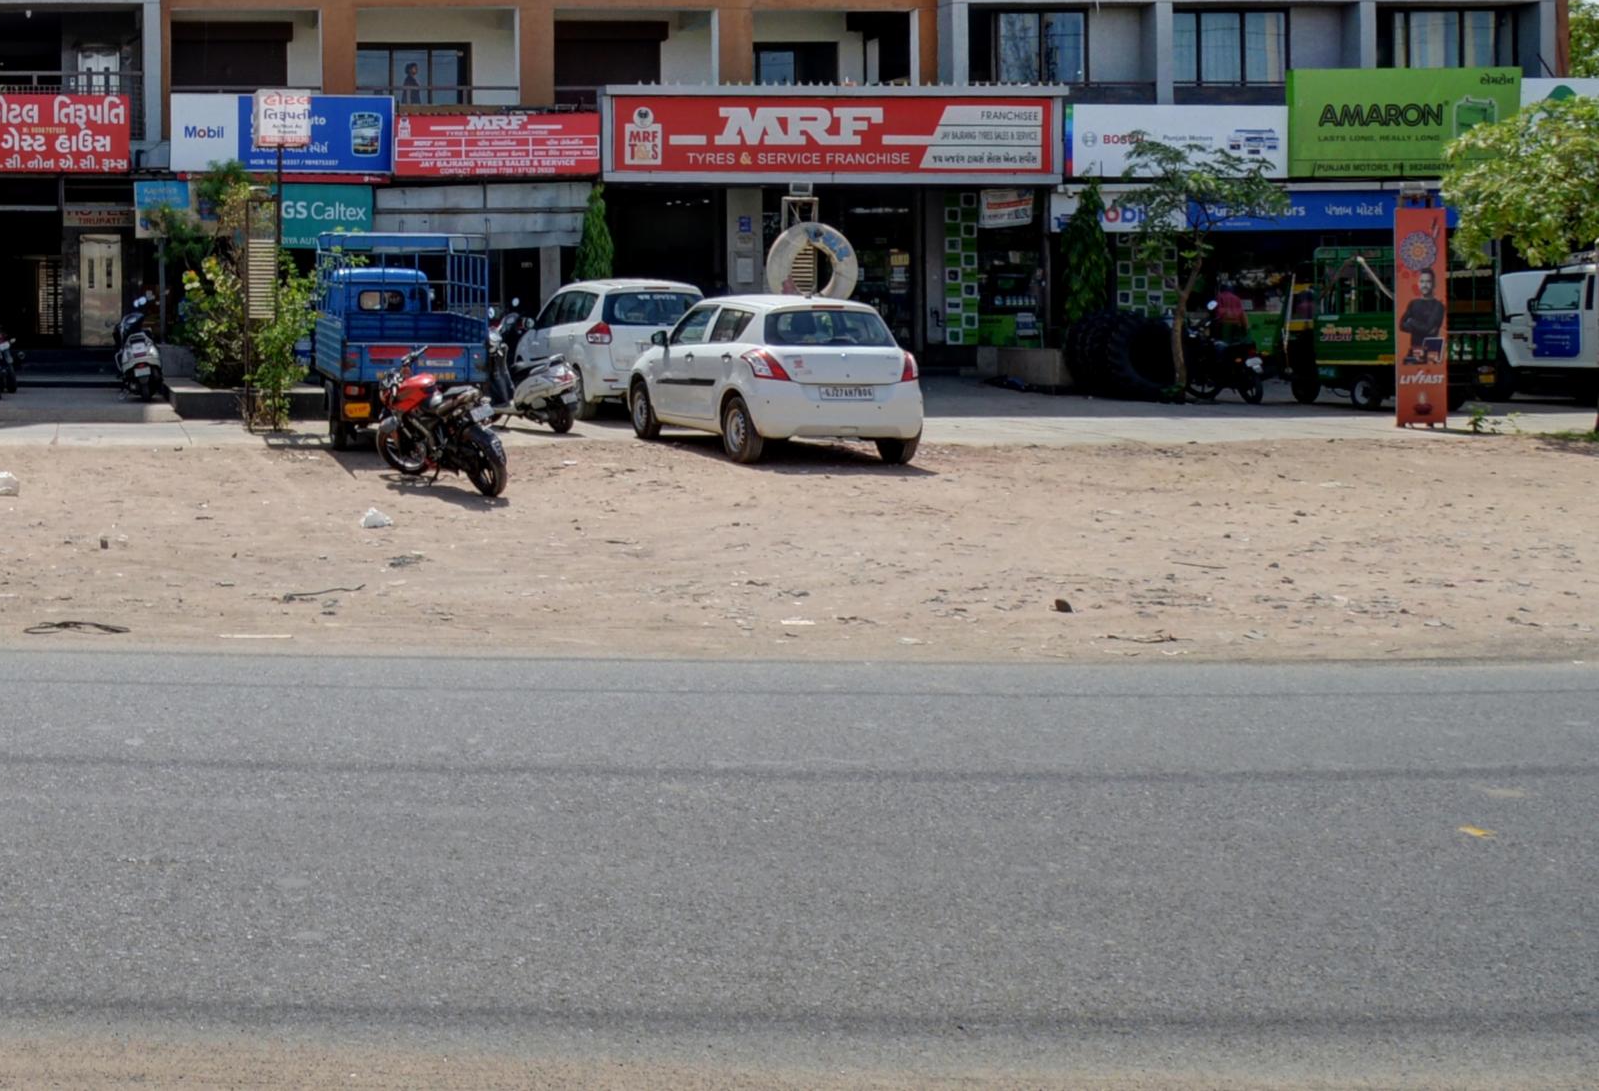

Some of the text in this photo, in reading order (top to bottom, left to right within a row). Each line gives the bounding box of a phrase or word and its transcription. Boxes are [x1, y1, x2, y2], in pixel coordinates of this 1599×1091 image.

[53, 95, 125, 128] તિરૂપતિ
[980, 111, 1039, 121] FRANCHISEE
[1318, 103, 1443, 127] AMARON
[465, 115, 528, 130] MRF
[714, 106, 884, 146] MRF
[184, 126, 225, 139] Mobil
[628, 130, 658, 143] MRF
[1318, 134, 1346, 142] LASTS
[1379, 134, 1412, 142] REALLY
[1414, 134, 1440, 142] LONG
[1, 127, 111, 152] ગેસ્ટ હાઉસ
[628, 143, 658, 160] T&S
[687, 152, 911, 165] TYRES & SERVICE FRANCHISE
[1317, 163, 1351, 173] PUNJAB
[281, 200, 367, 221] GS Caltex
[78, 217, 121, 225] TIRUPATI
[299, 237, 317, 245] AUT
[1399, 370, 1444, 384] LIVFAST
